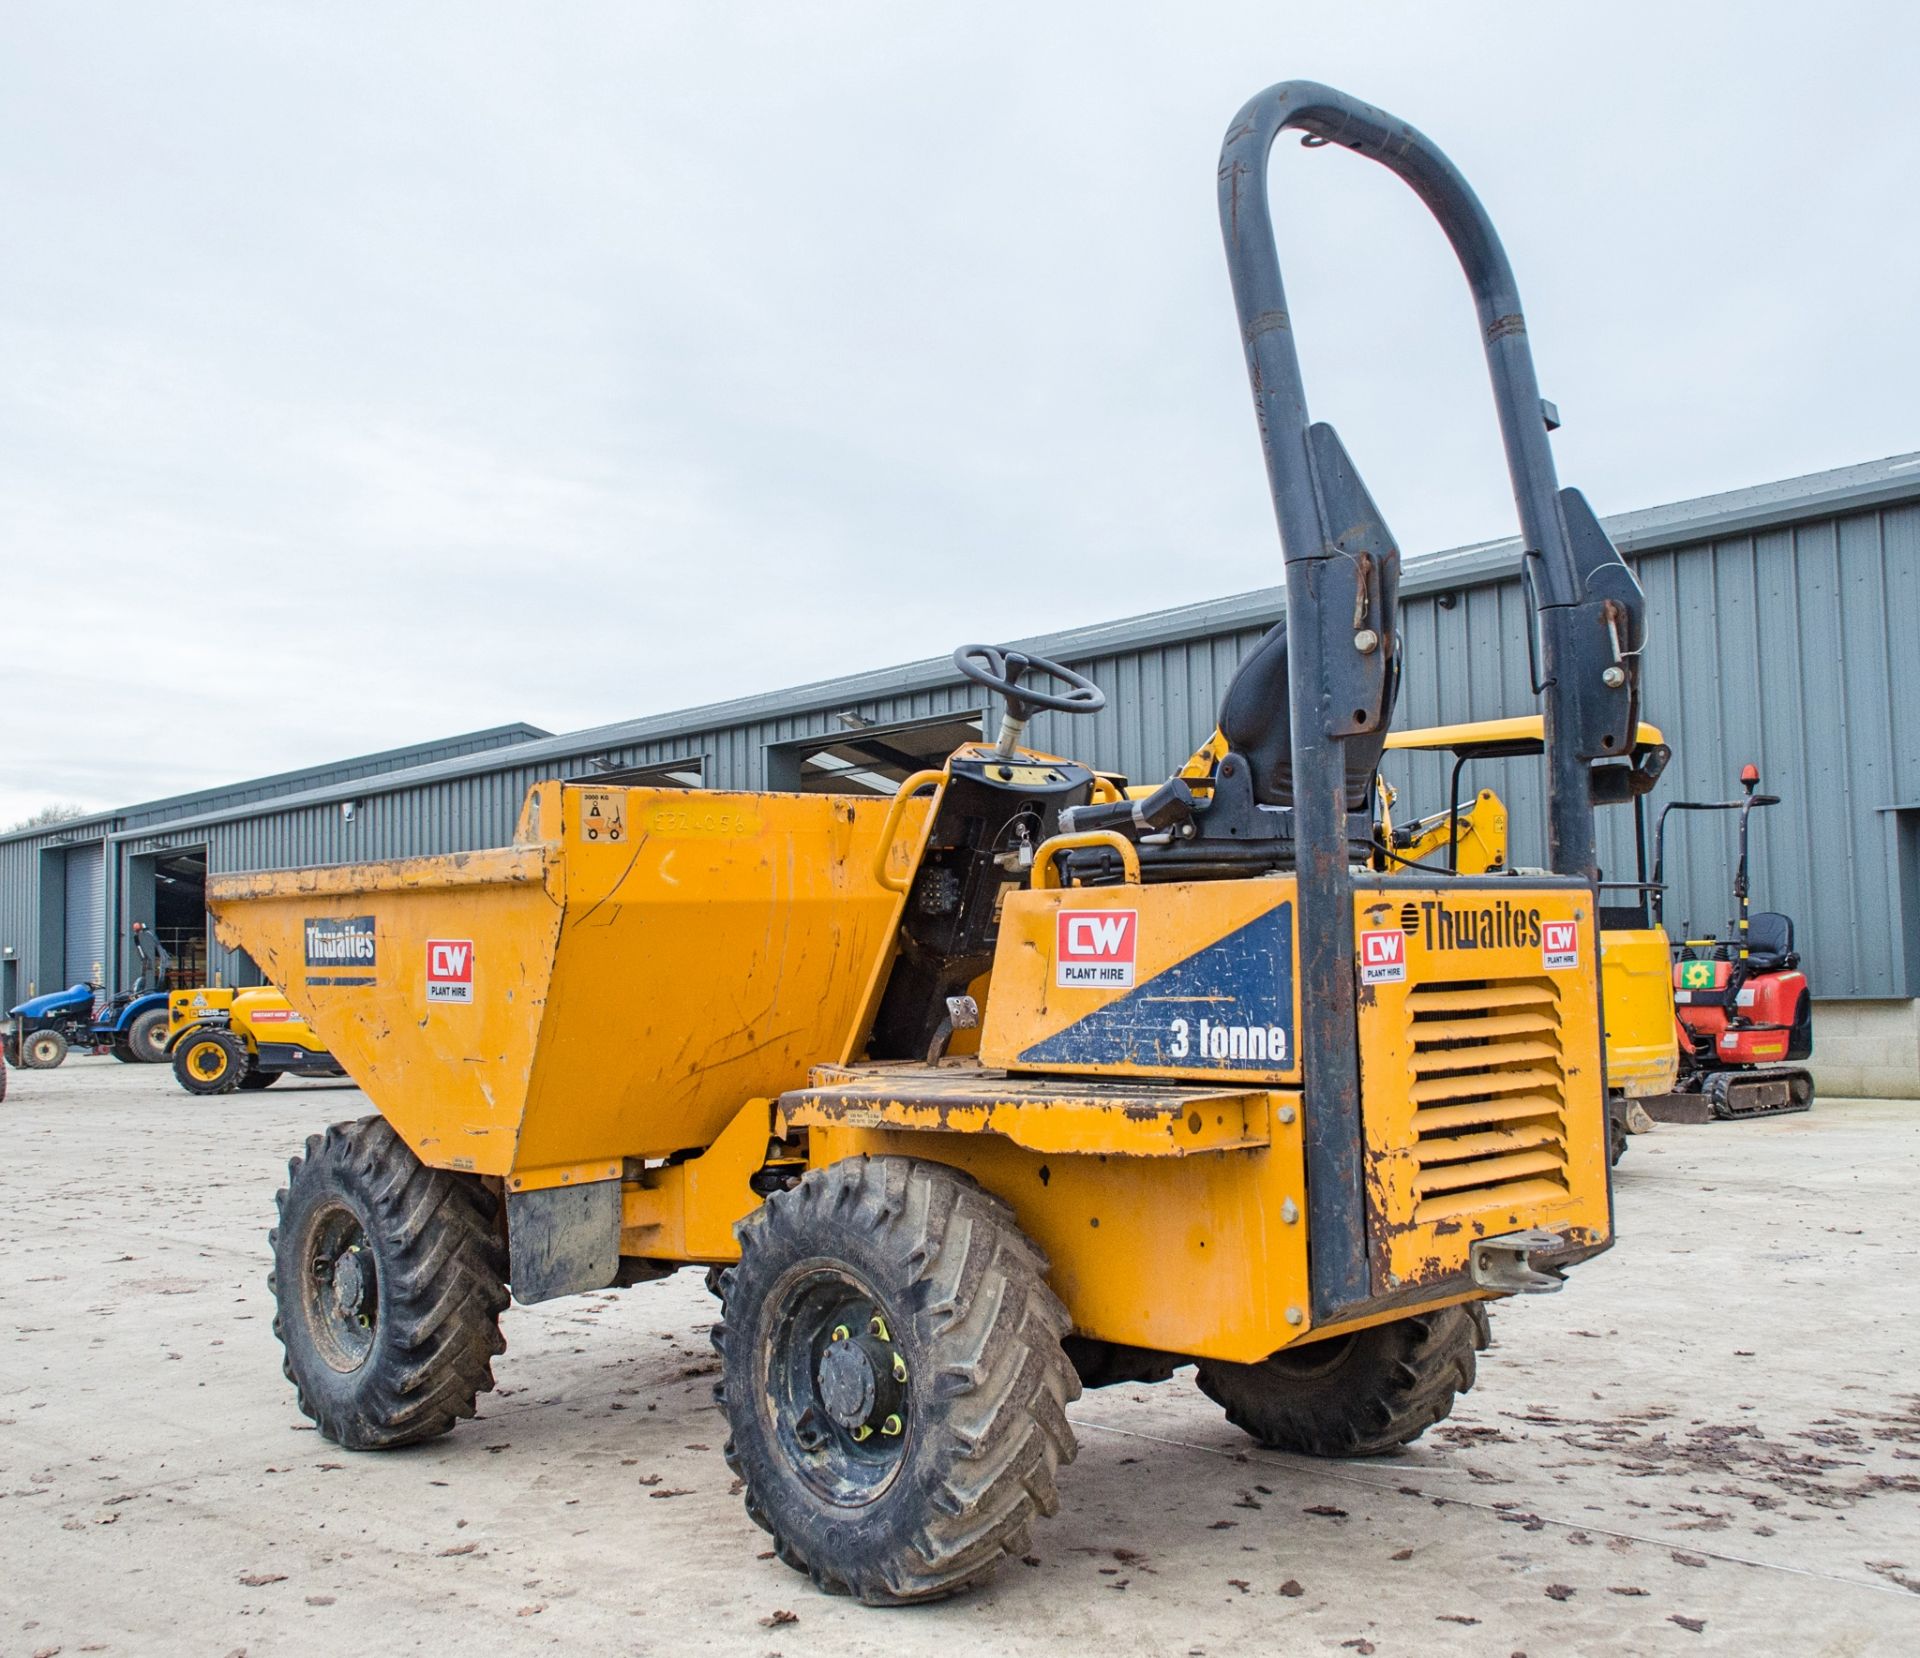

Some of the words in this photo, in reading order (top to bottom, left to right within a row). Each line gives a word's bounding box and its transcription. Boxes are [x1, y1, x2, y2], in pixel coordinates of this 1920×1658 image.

[1067, 917, 1128, 955] CW
[1421, 901, 1541, 950] Thwaites
[1547, 926, 1573, 949] CW
[306, 926, 374, 958] Thwaites
[1367, 935, 1399, 962] CW
[432, 946, 467, 976] CW
[1367, 968, 1386, 978] PLANT
[1387, 967, 1400, 976] HIRE
[1547, 955, 1562, 964] PLANT
[1563, 955, 1574, 963] HIRE
[1065, 968, 1097, 979] PLANT
[1100, 968, 1124, 980] HIRE
[431, 986, 450, 996] PLANT
[451, 987, 466, 997] HIRE
[1171, 1018, 1189, 1058] 3
[1200, 1018, 1286, 1060] tonne
